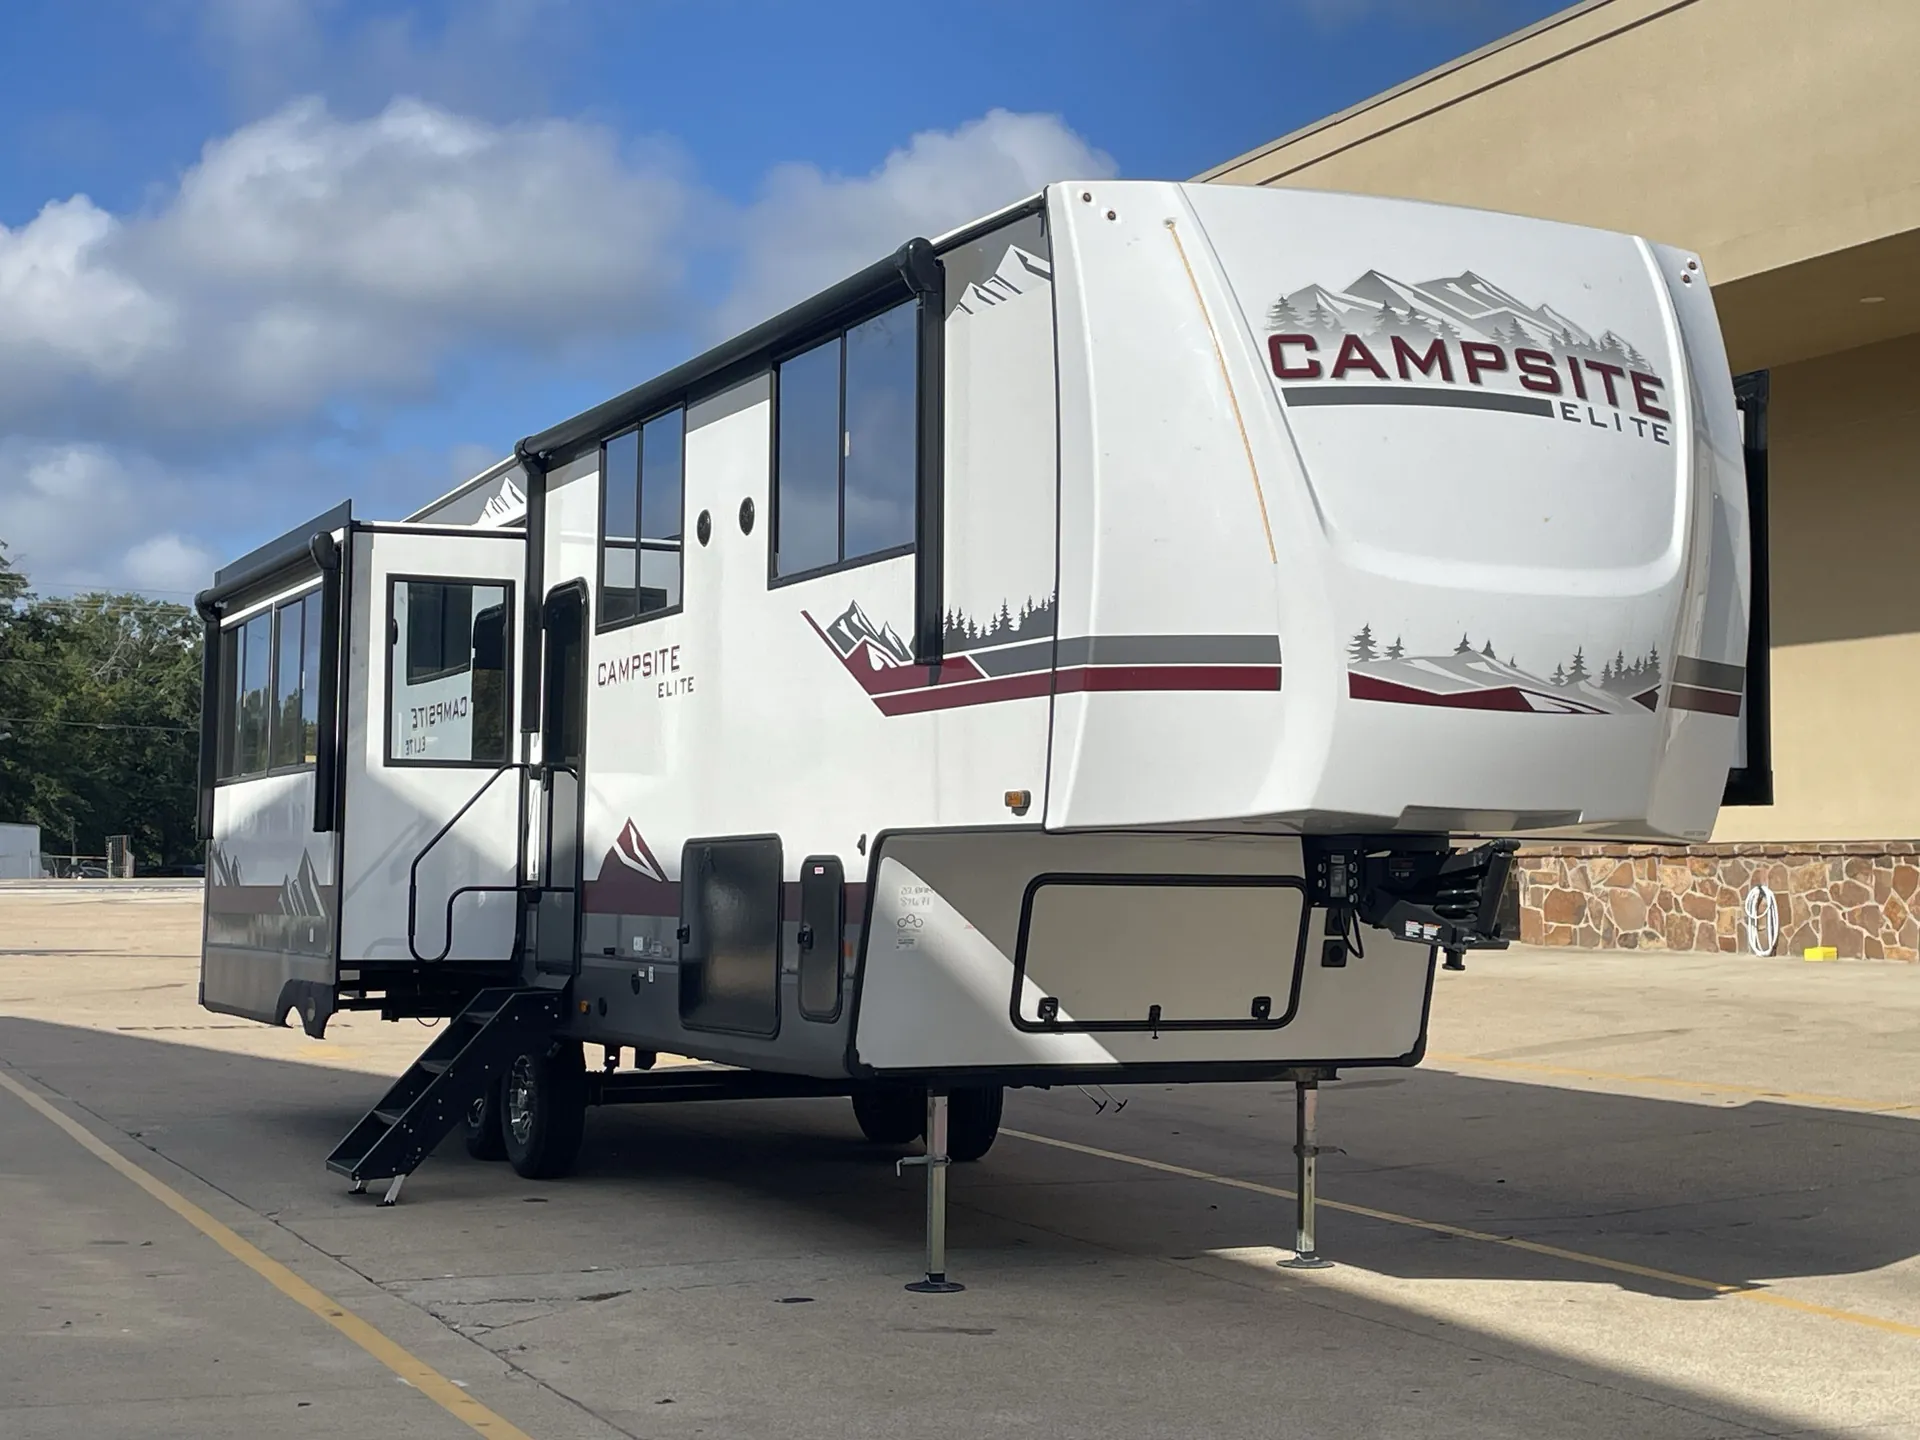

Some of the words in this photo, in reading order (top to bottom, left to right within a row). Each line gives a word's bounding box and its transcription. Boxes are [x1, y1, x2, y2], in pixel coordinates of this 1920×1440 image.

[1267, 333, 1672, 424] CAMPSITE
[1559, 400, 1671, 446] ELITE
[597, 644, 681, 687] CAMPSITE
[657, 676, 695, 699] ELITE
